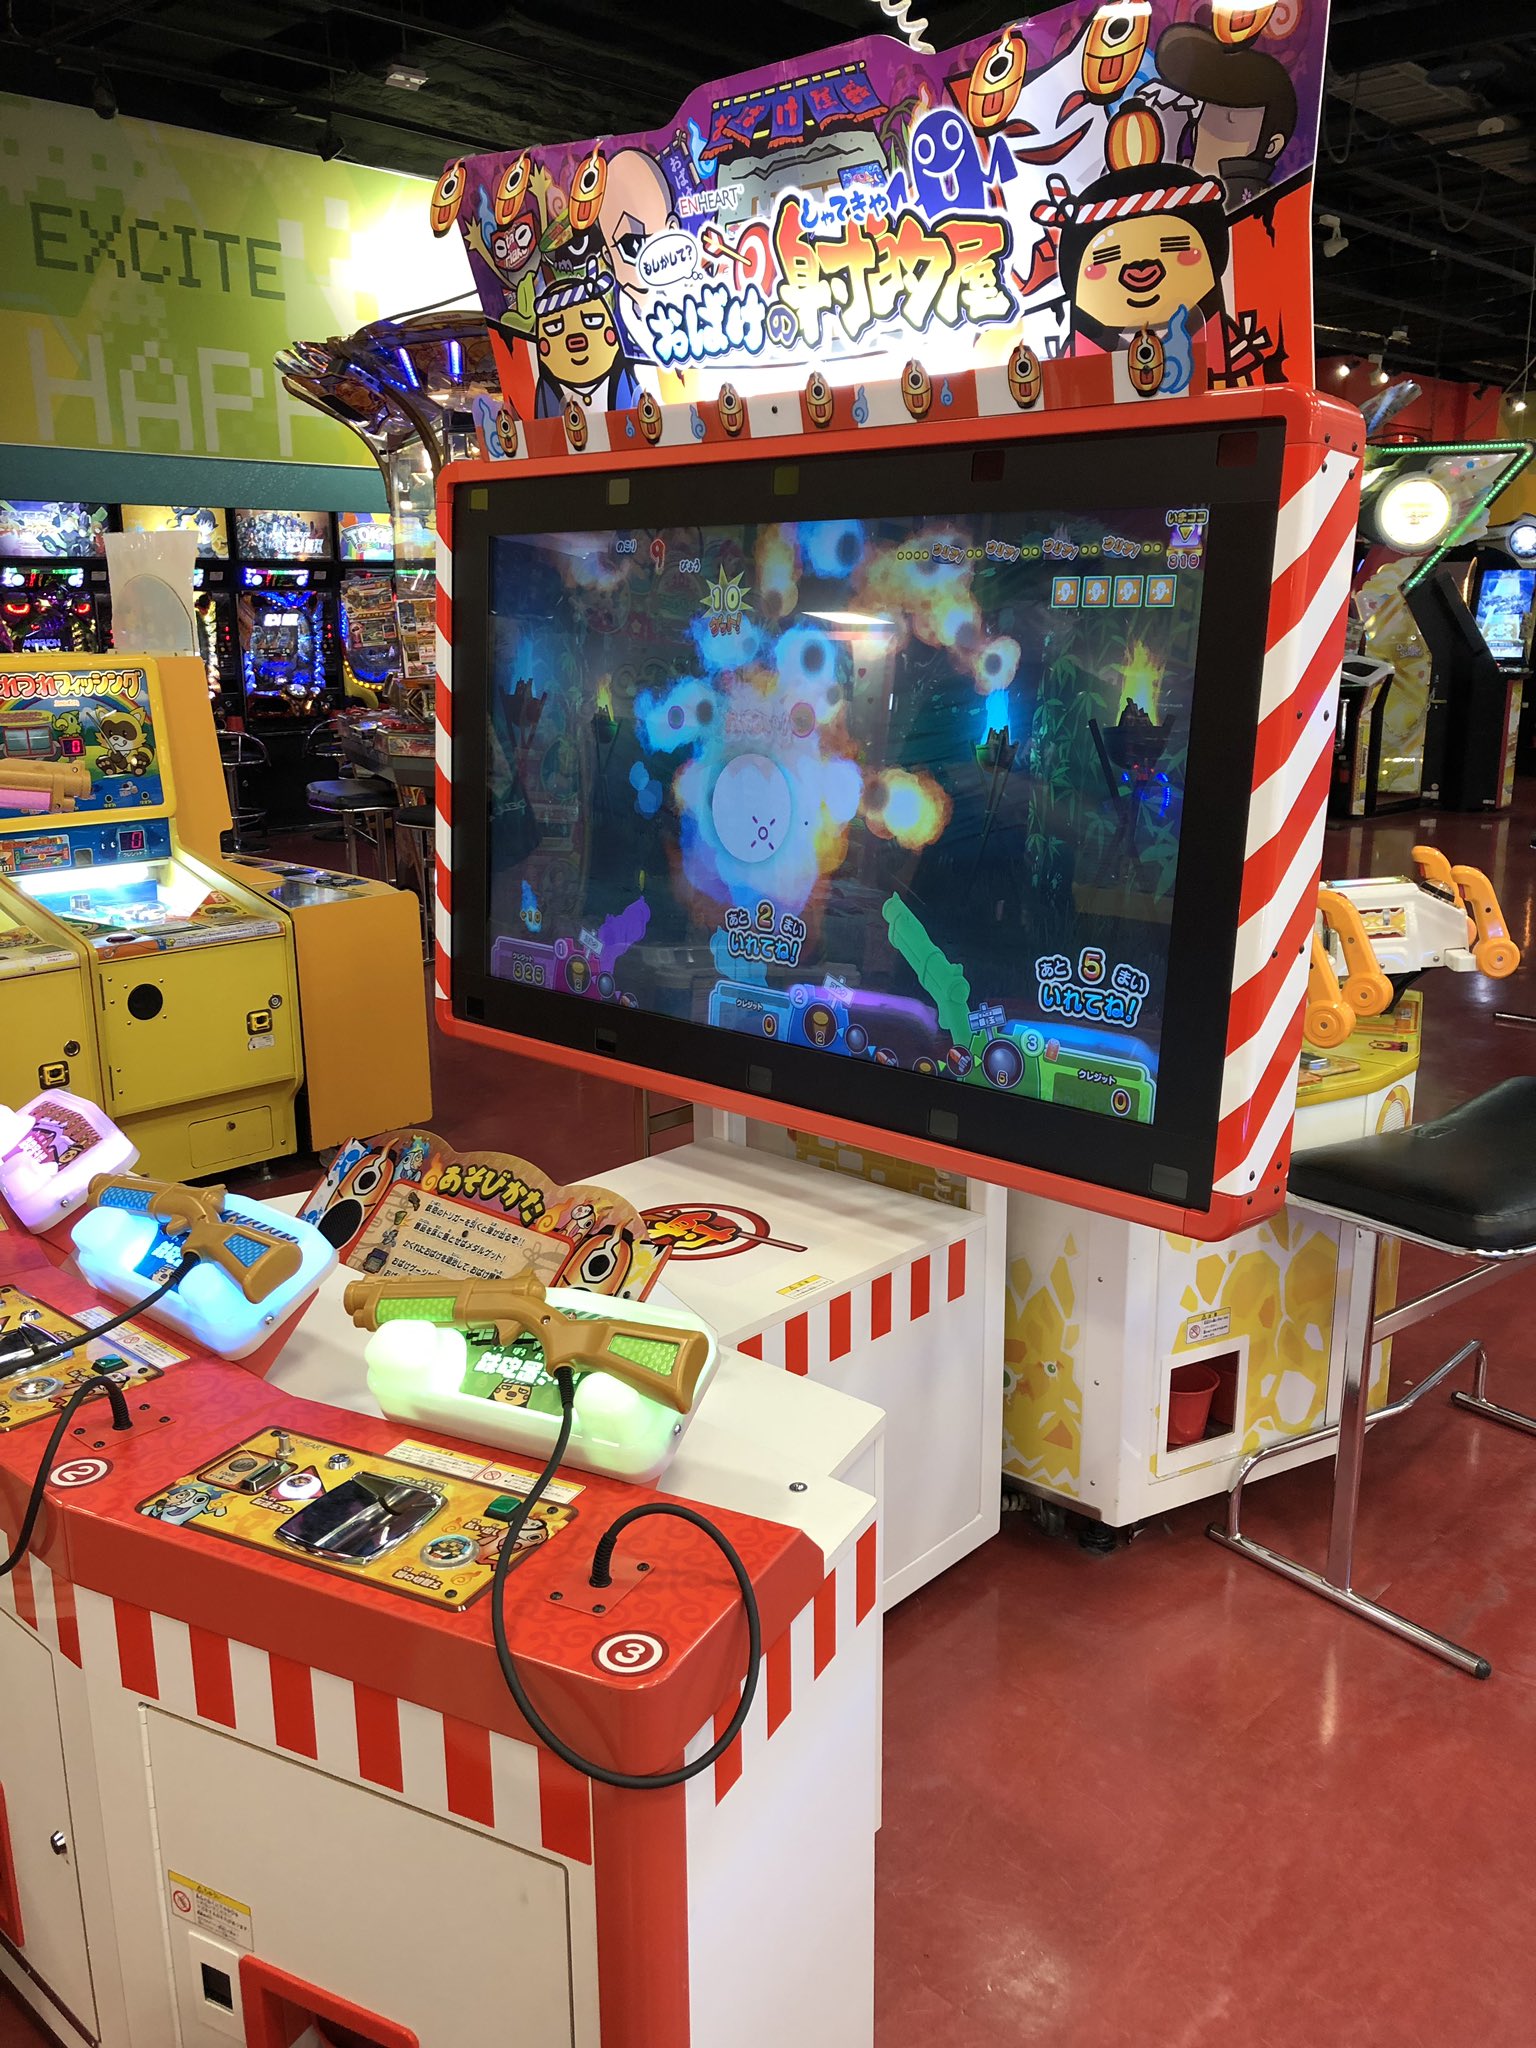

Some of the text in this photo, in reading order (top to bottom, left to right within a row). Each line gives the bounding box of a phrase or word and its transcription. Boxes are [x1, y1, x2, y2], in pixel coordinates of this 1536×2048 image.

[680, 187, 738, 216] ENHEART
[800, 191, 888, 229] しゃてきや
[30, 202, 286, 301] EXCITE
[643, 245, 693, 276] もしかして?
[1165, 508, 1209, 527] いまココ
[711, 585, 742, 613] 10
[131, 832, 142, 849] 0
[726, 901, 804, 938] あと 2 まい
[729, 930, 800, 964] いれてね!
[1038, 949, 1146, 995] あと 5 まい
[1041, 983, 1139, 1025] いれてね!
[1027, 1035, 1039, 1051] 3
[1078, 1069, 1117, 1086] クレジット
[1112, 1089, 1130, 1114] 0
[438, 1163, 545, 1227] あそびかた
[61, 1465, 95, 1482] 2
[615, 1643, 646, 1664] 3
